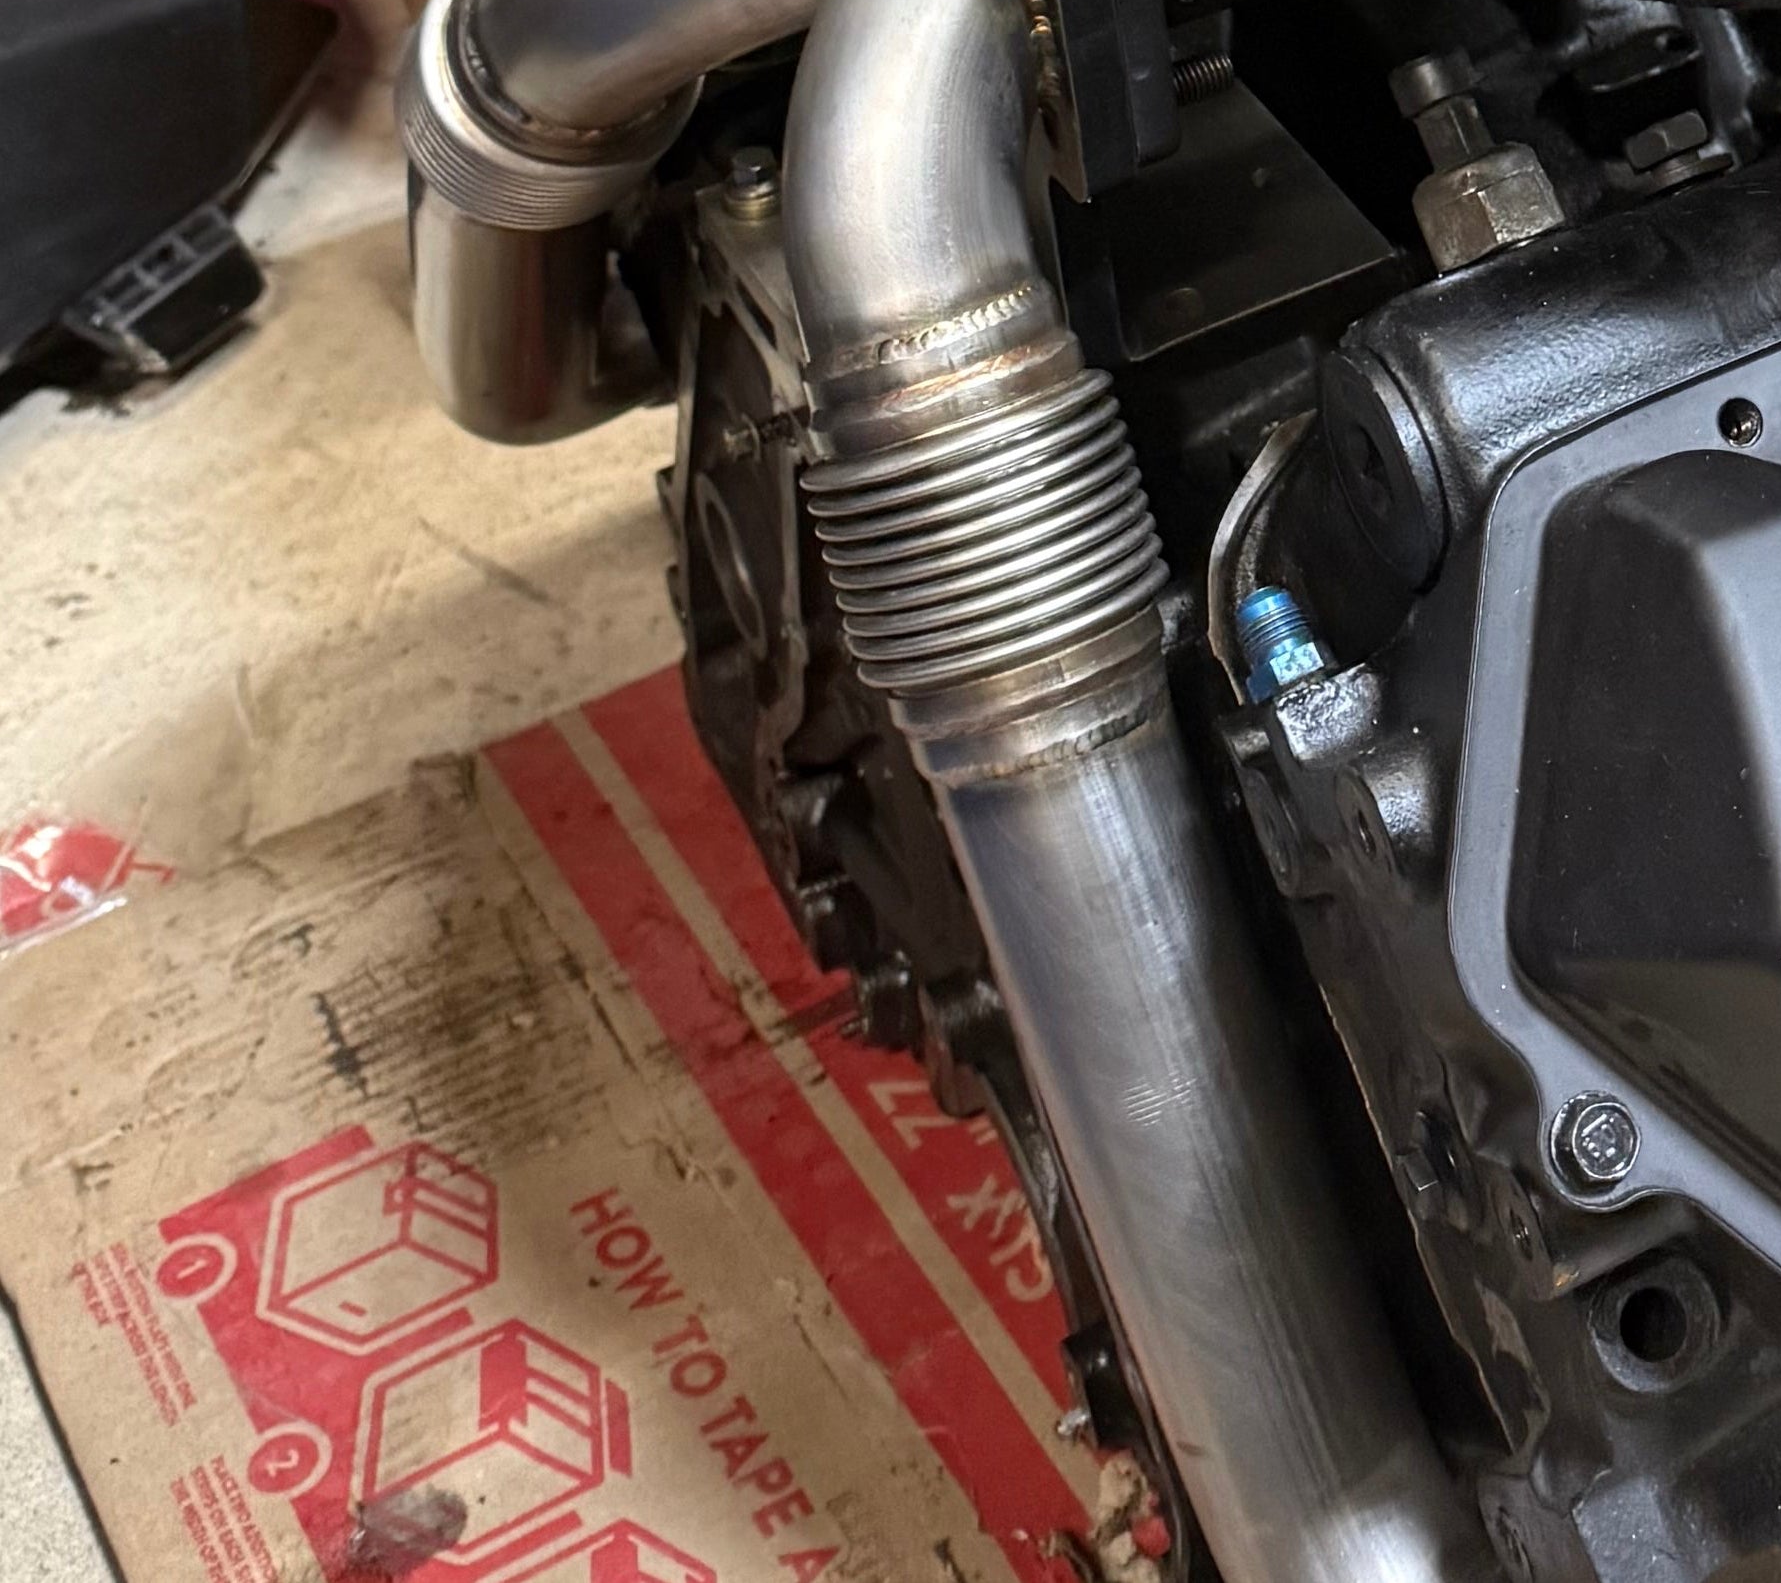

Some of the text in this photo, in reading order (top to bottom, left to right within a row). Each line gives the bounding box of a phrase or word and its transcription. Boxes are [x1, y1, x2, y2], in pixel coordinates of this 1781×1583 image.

[569, 1186, 684, 1311] HOW
[652, 1313, 727, 1400] TO
[700, 1394, 815, 1539] TAPE
[265, 1448, 300, 1478] 2
